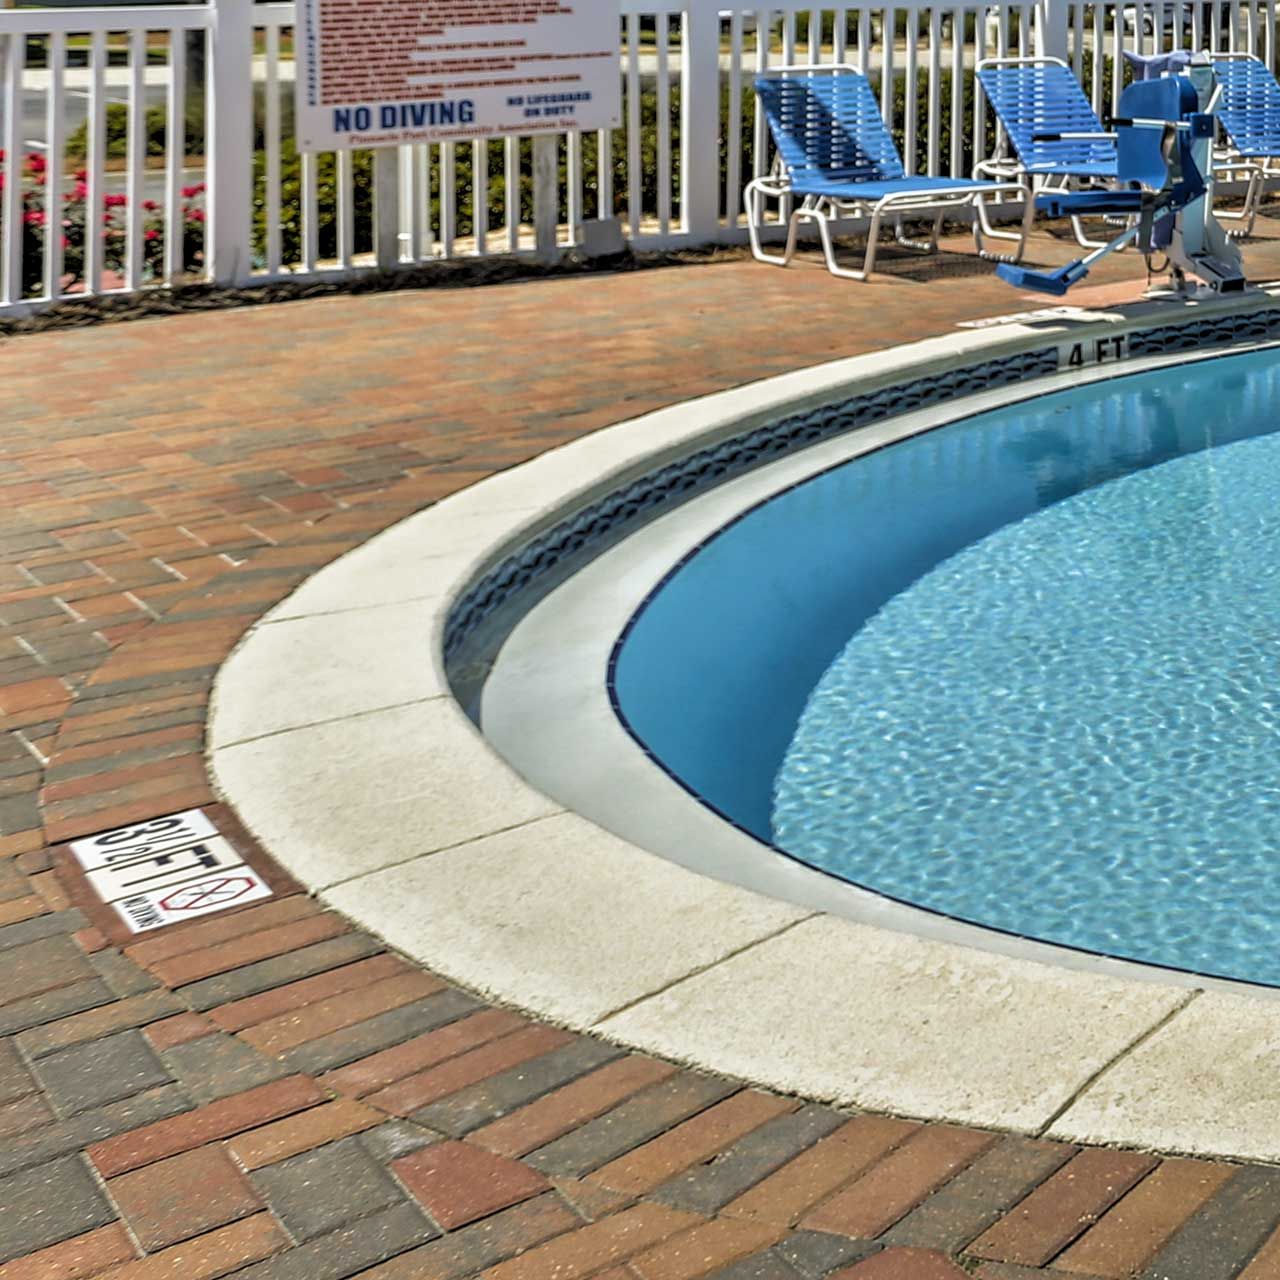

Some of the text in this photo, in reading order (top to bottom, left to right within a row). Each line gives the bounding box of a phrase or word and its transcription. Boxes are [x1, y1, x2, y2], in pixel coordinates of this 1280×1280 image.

[506, 91, 592, 106] NO LIFEGUARD
[524, 104, 575, 118] ON DUTY
[334, 99, 475, 132] NO DIVING
[1069, 336, 1125, 367] 4 FT
[110, 843, 221, 888] FT
[121, 895, 166, 928] NO DIVING
